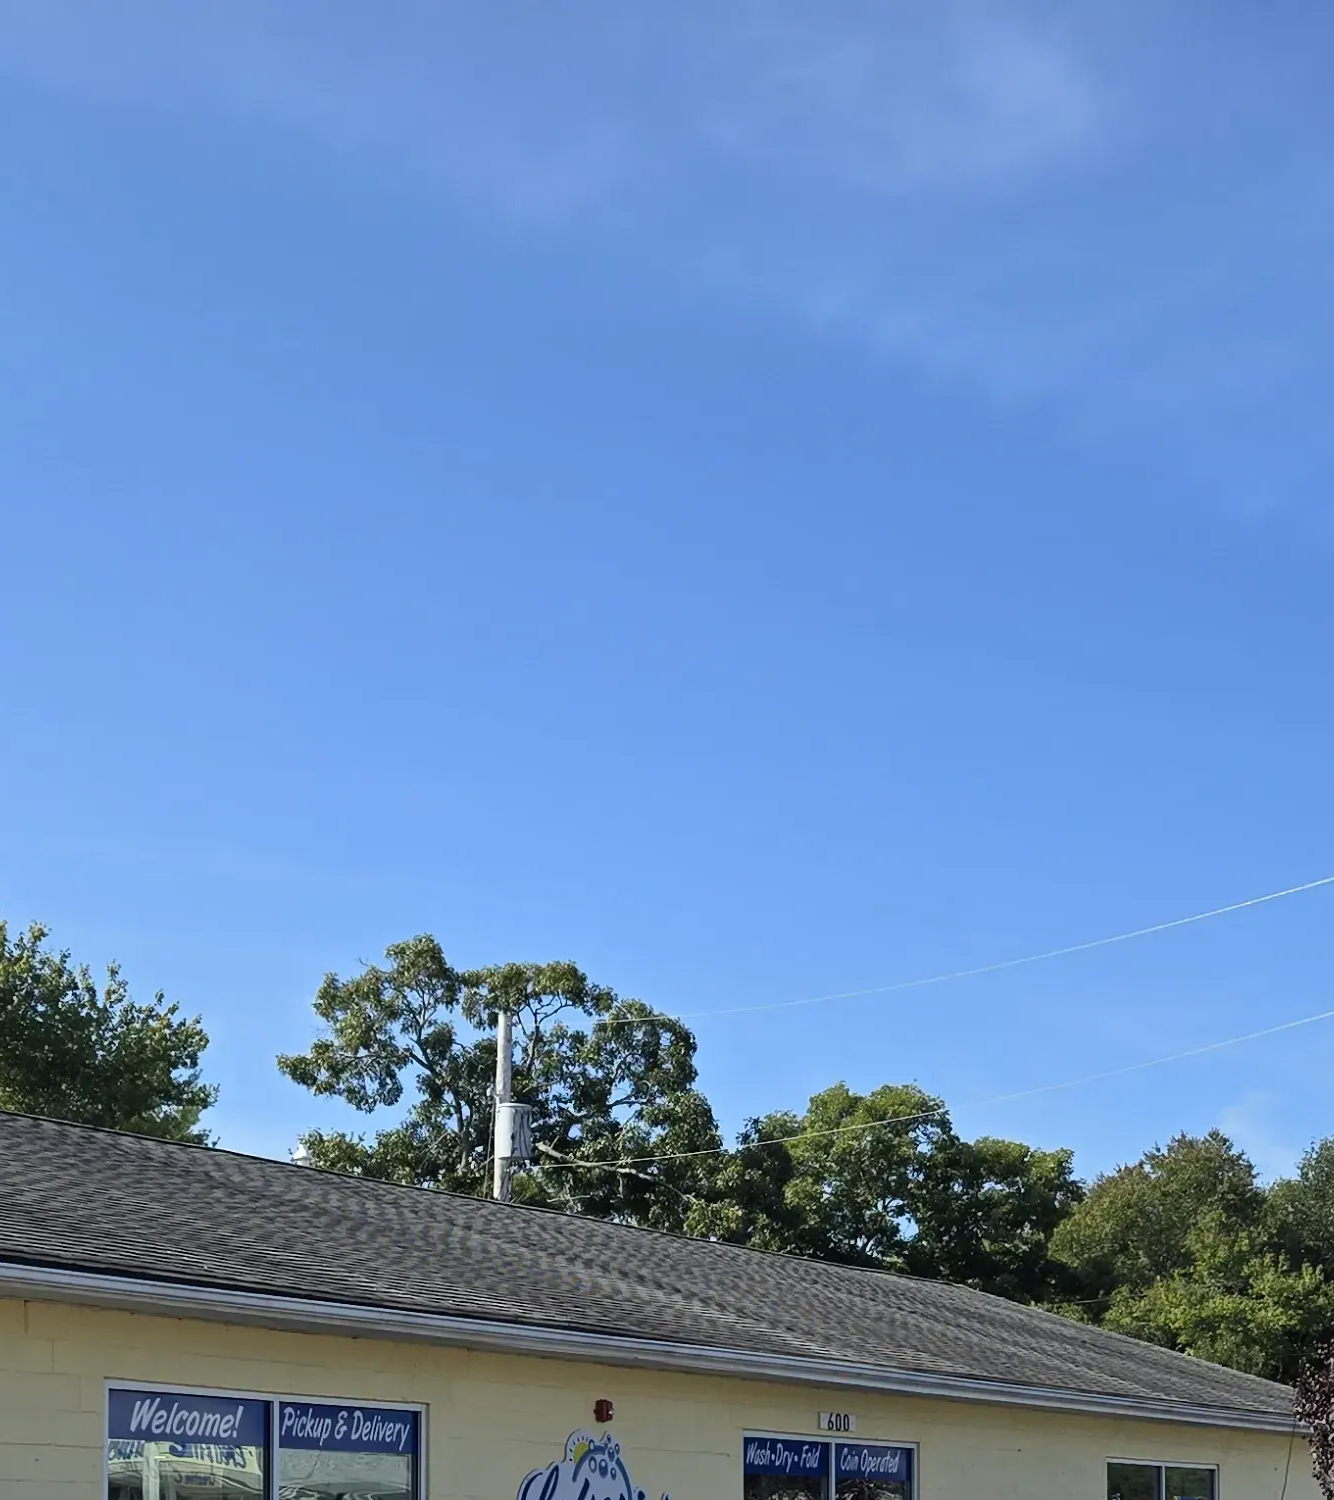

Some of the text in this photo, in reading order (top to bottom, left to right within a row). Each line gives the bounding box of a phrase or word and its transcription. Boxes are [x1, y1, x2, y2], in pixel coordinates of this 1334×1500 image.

[129, 1397, 245, 1439] Welcome!
[281, 1406, 411, 1452] Pickup & Delivery
[827, 1412, 850, 1432] 600
[800, 1444, 822, 1469] Fold
[840, 1447, 901, 1477] Coin Operated
